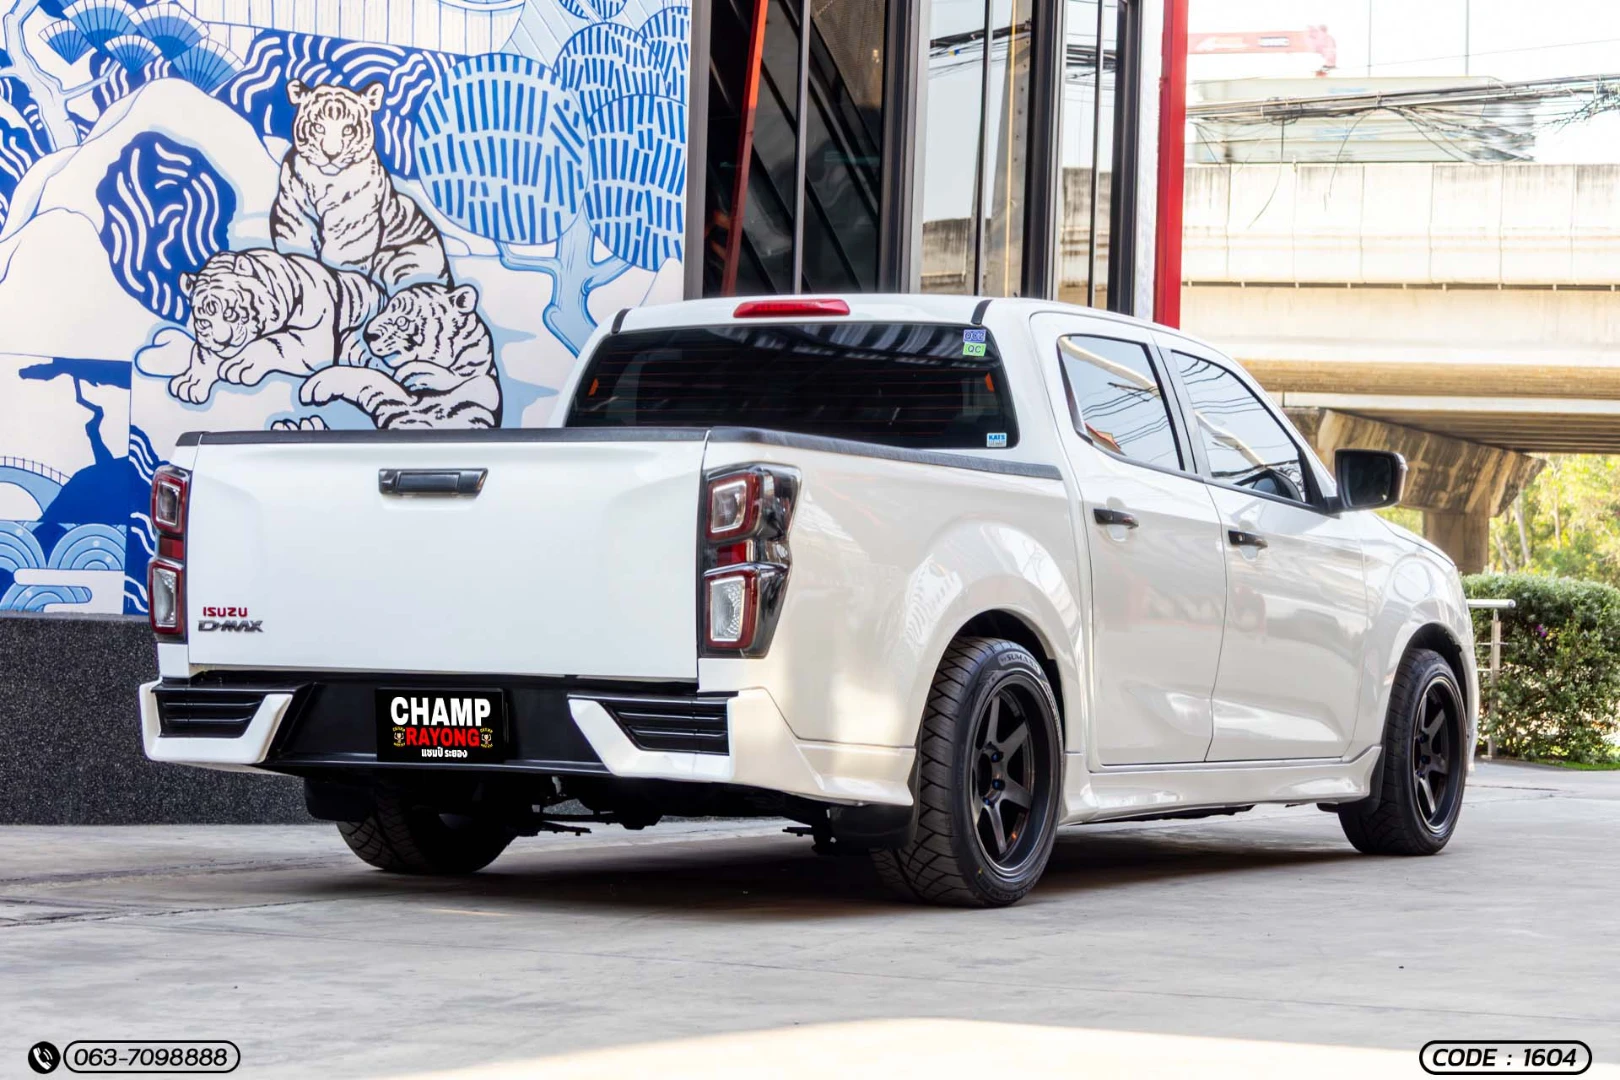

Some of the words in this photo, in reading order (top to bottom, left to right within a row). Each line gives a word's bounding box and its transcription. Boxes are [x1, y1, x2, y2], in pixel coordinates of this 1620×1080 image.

[967, 344, 982, 354] QC
[202, 606, 248, 618] ISUZU
[198, 620, 264, 633] D-MAX
[390, 696, 491, 727] CHAMP
[405, 726, 481, 748] RAYONG
